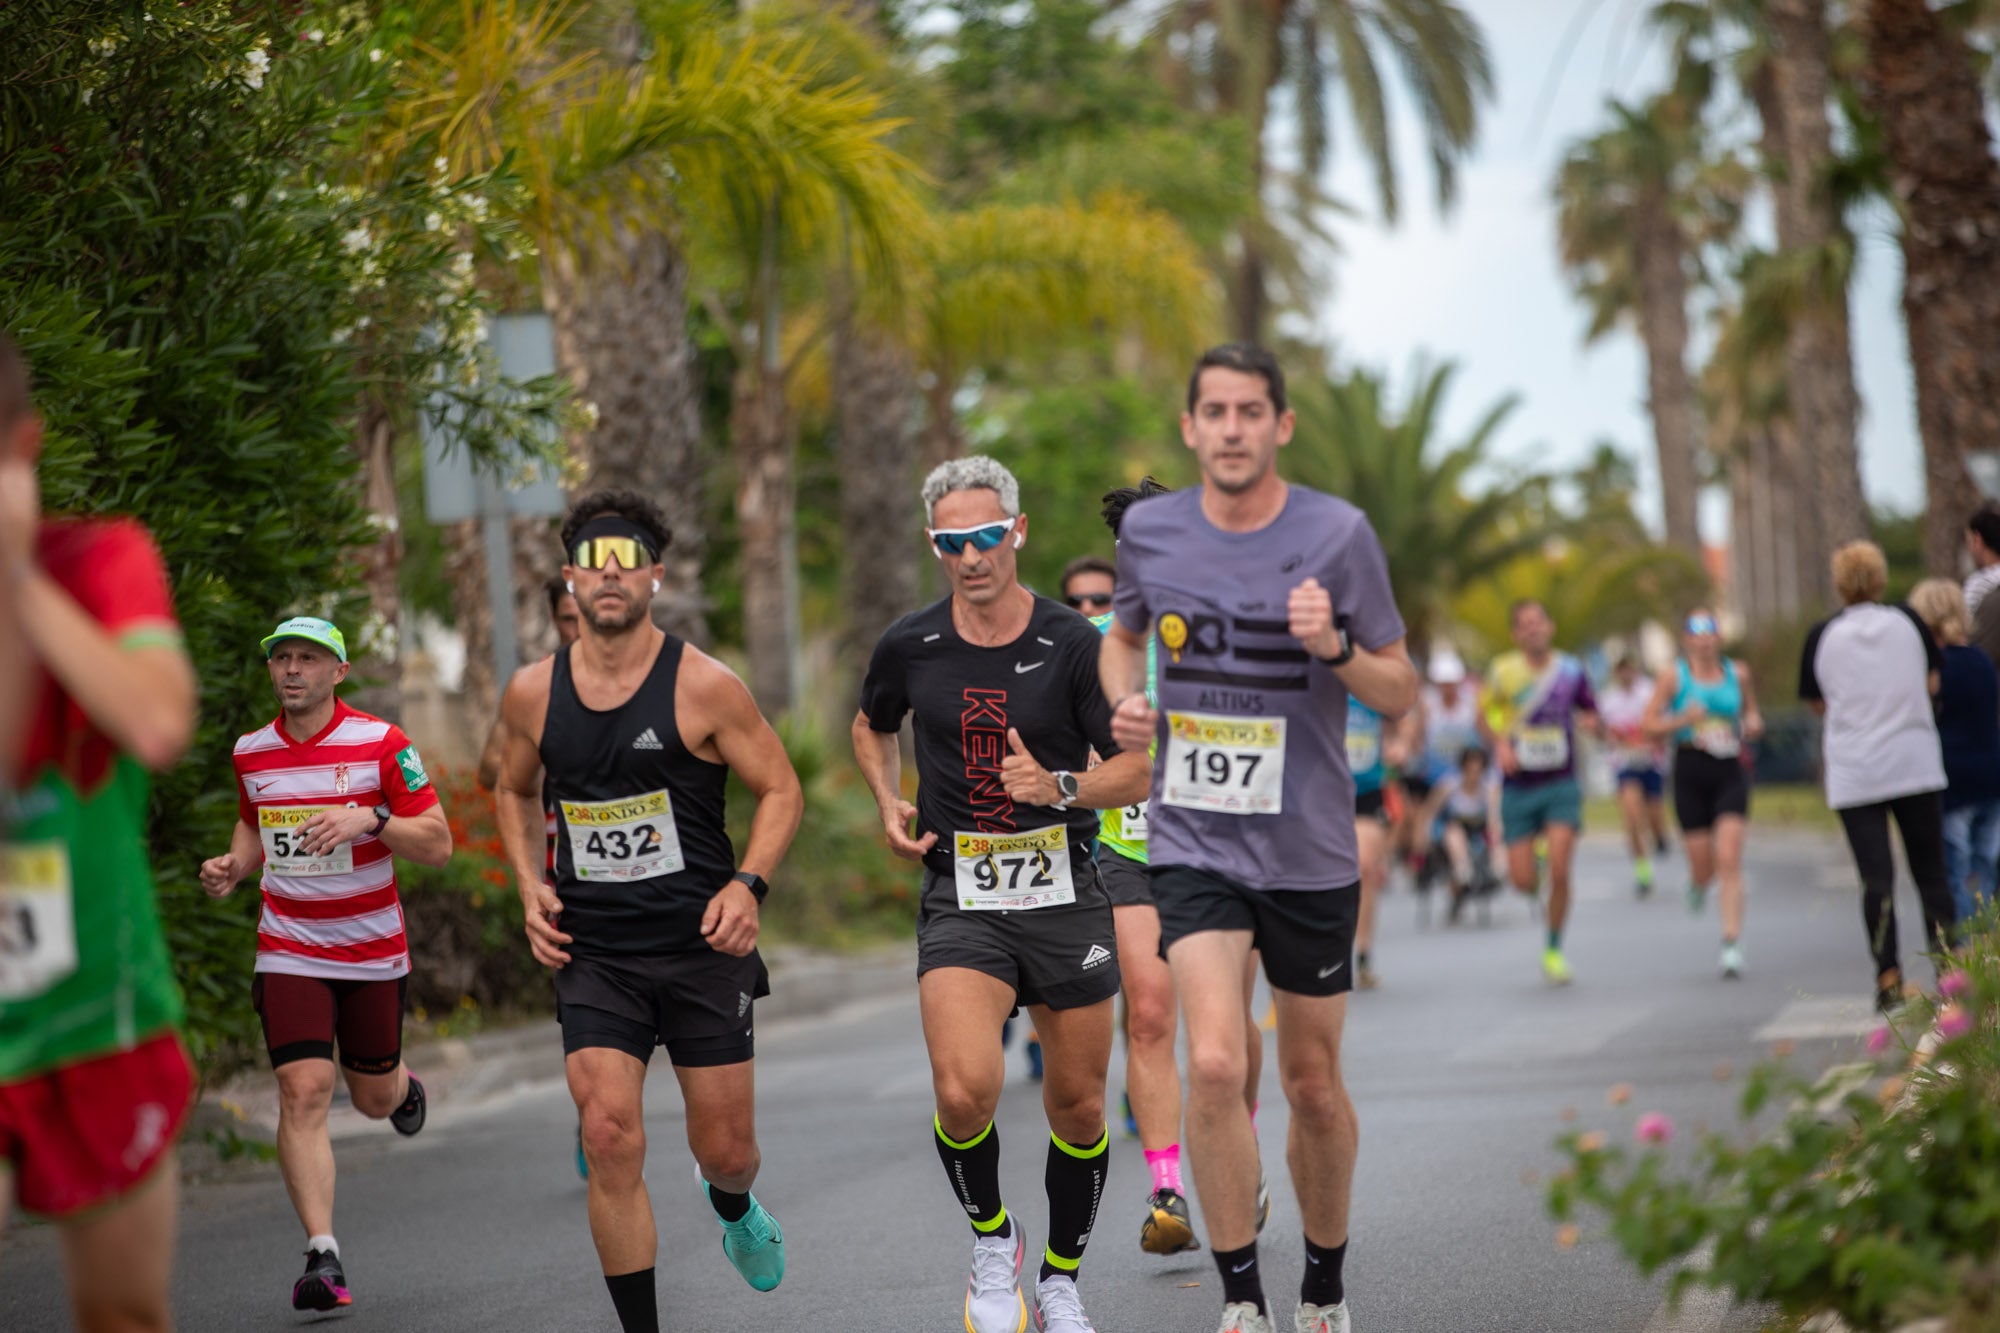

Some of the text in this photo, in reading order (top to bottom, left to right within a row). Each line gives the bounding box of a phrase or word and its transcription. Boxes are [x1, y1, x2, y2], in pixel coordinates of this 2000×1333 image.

[1184, 749, 1263, 787] 197
[268, 811, 282, 823] 38
[273, 832, 336, 858] 52
[586, 824, 661, 860] 432
[971, 838, 990, 852] 38
[973, 856, 1055, 892] 972
[954, 1159, 972, 1204] COMPRESSPORT
[1086, 1169, 1101, 1231] COMPRESSPORT
